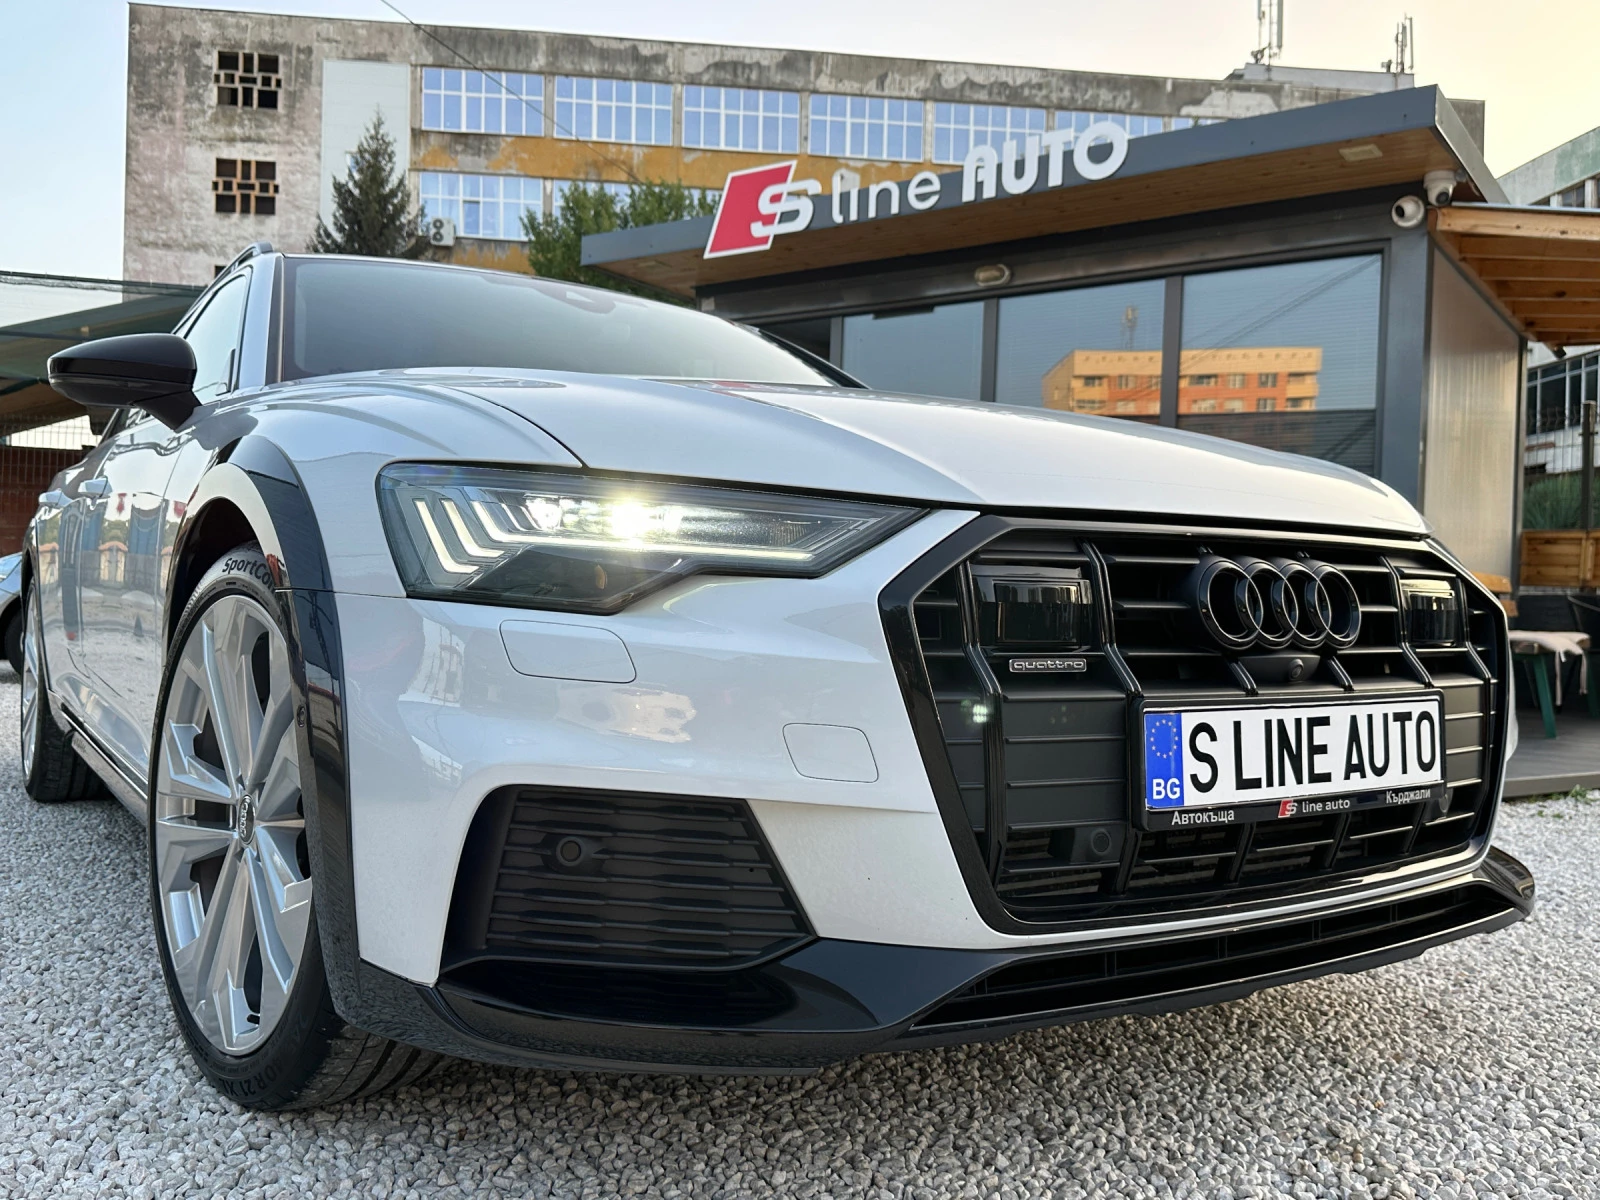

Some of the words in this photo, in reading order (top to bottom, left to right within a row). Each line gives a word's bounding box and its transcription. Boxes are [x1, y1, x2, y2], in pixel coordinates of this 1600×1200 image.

[750, 178, 822, 238] S
[832, 168, 941, 224] line
[962, 120, 1129, 202] AUTO
[1013, 660, 1084, 671] quattro
[1189, 722, 1219, 793] S
[1233, 716, 1332, 790] LINE
[1343, 710, 1436, 781] AUTO
[1152, 777, 1181, 800] BG
[1386, 788, 1431, 804] Кърджали
[1302, 801, 1323, 813] line
[1325, 798, 1350, 811] auto
[1171, 810, 1235, 826] Автокъща
